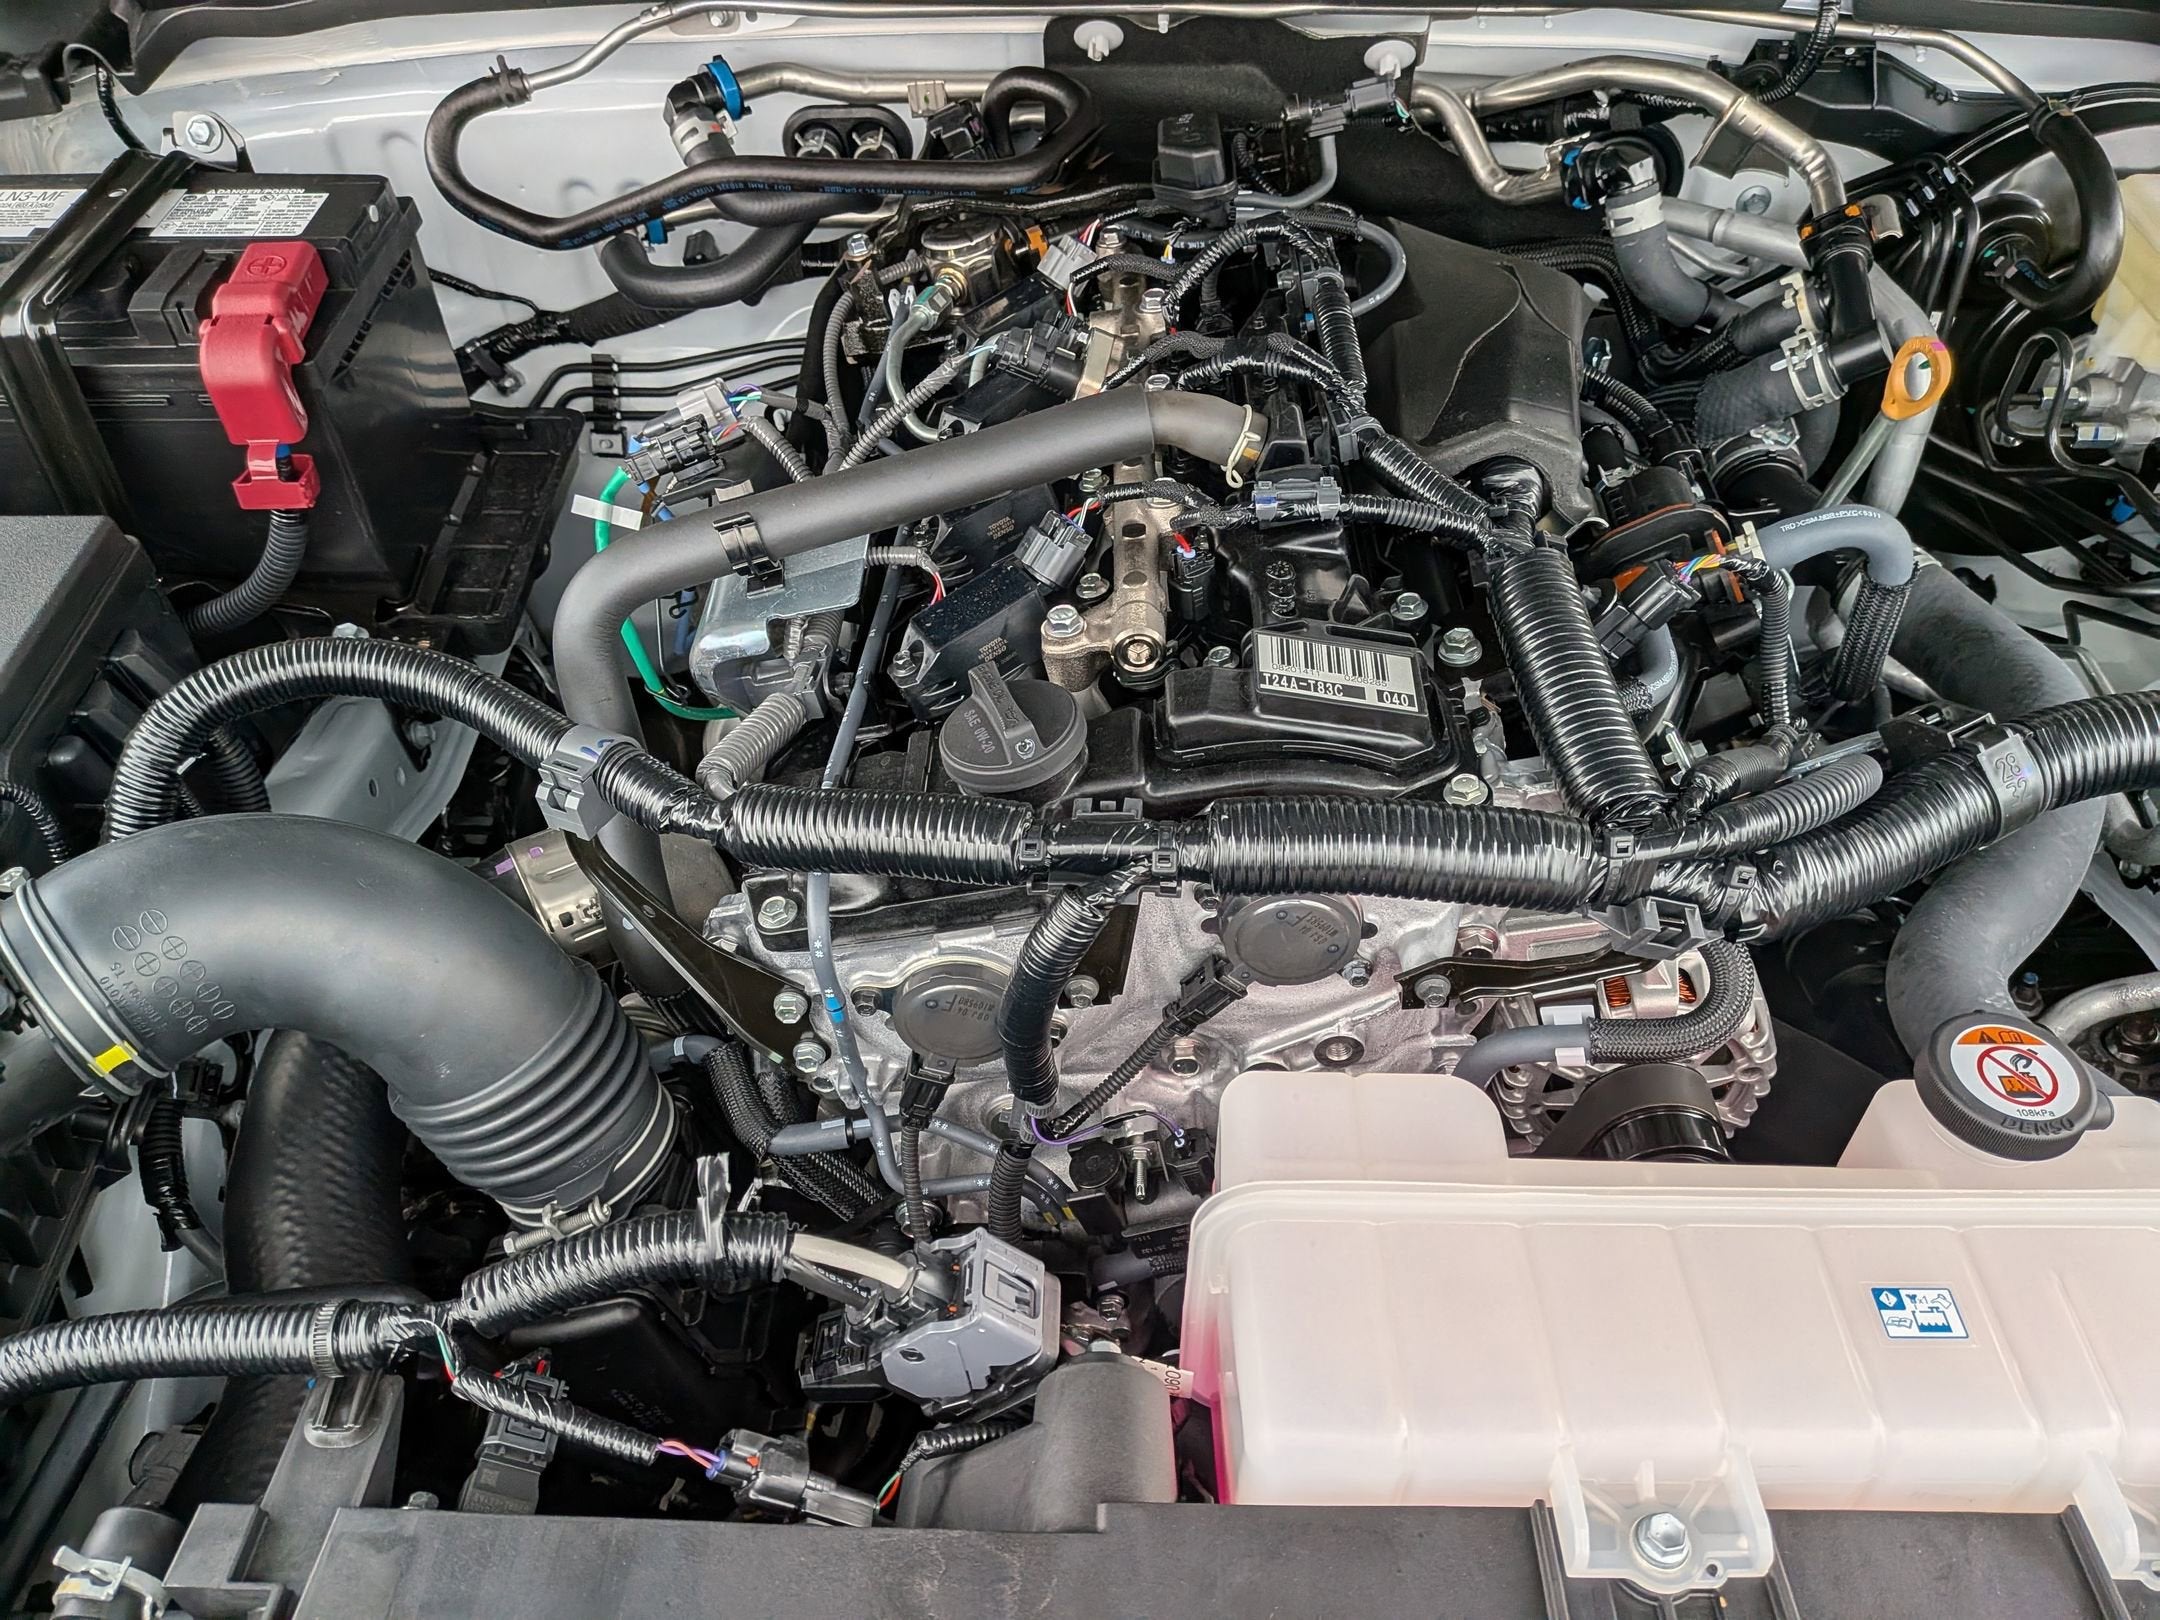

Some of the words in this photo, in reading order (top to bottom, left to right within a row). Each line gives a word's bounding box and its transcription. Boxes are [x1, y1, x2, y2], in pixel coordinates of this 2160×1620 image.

[979, 636, 1003, 653] TOYOTA
[1262, 672, 1344, 698] T24A-T83C
[1383, 691, 1409, 707] 040
[963, 709, 982, 727] SAE
[2016, 1108, 2056, 1118] 108kPa
[2000, 1116, 2076, 1136] DENSO
